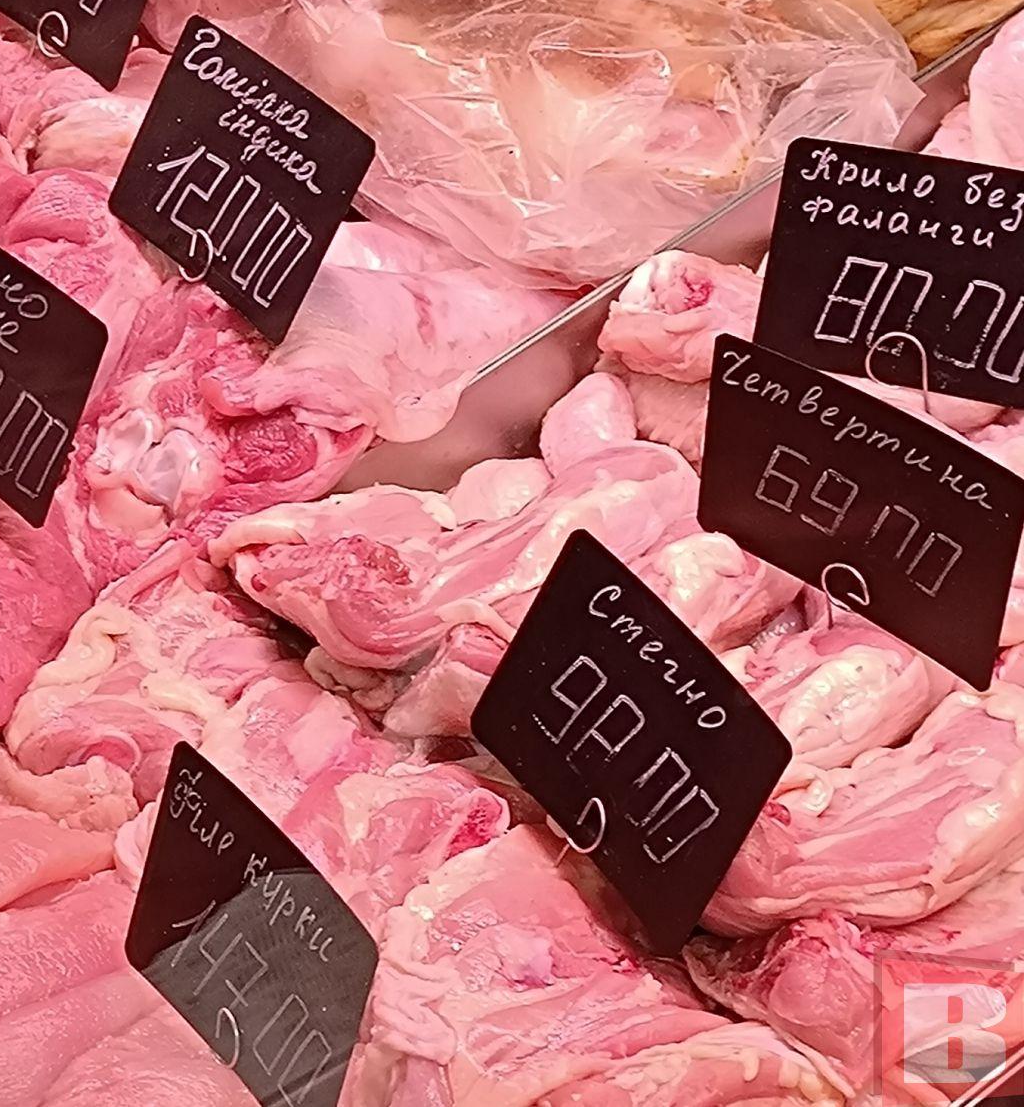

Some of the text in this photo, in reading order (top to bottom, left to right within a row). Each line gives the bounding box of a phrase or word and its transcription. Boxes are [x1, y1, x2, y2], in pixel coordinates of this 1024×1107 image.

[217, 102, 324, 196] індика
[799, 145, 937, 200] Крило
[587, 583, 728, 730] Стегно
[242, 852, 335, 963] курки
